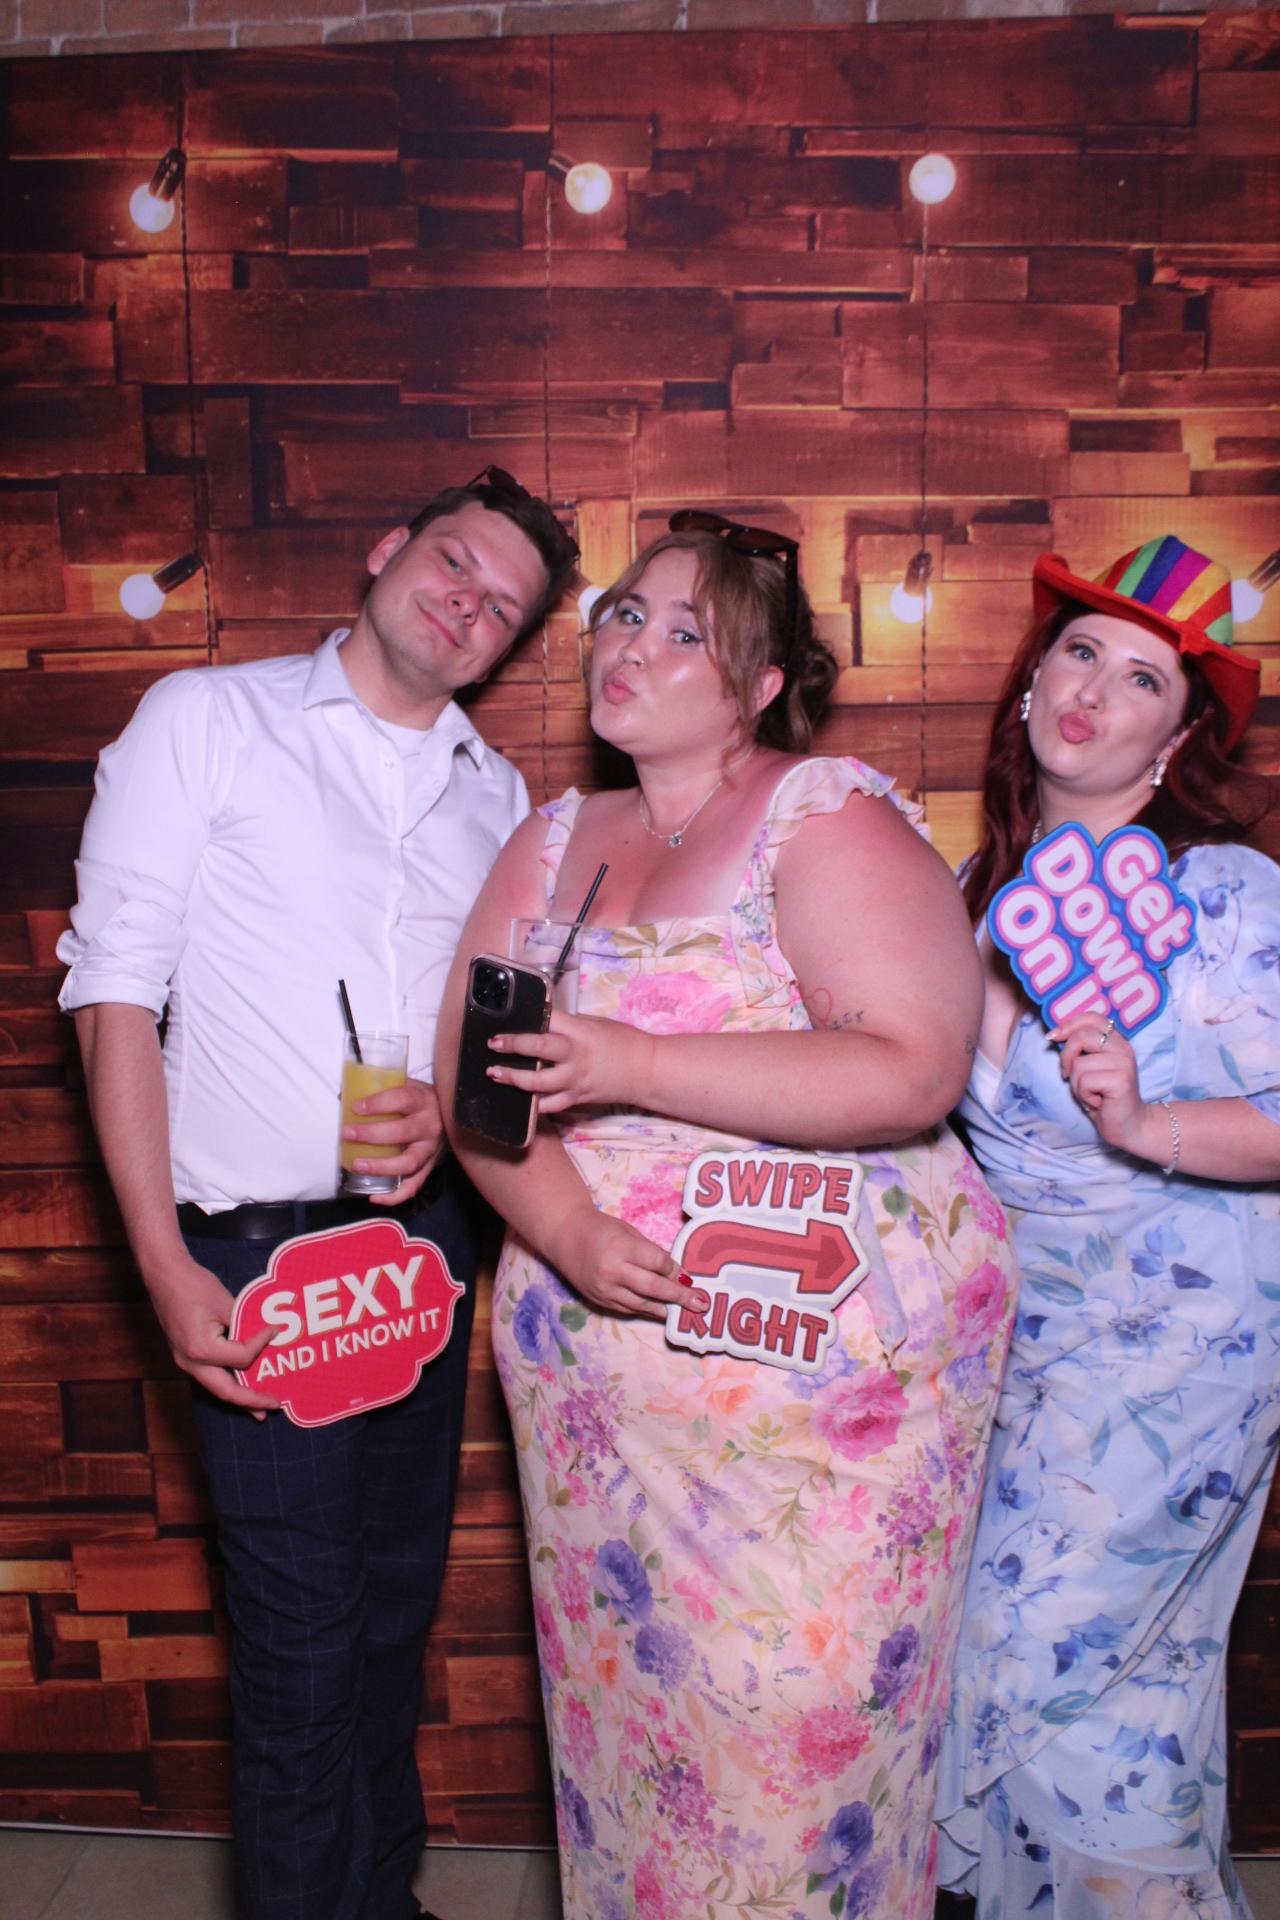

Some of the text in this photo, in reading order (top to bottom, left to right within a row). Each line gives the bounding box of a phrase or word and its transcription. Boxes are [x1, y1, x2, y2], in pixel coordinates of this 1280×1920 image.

[1032, 830, 1160, 1029] Down
[1103, 834, 1192, 961] Get
[996, 885, 1110, 1025] On I
[695, 1160, 853, 1215] SWIPE
[256, 1308, 441, 1382] AND I KNOW IT
[260, 1254, 425, 1346] SEXY
[678, 1287, 828, 1362] RIGHT
